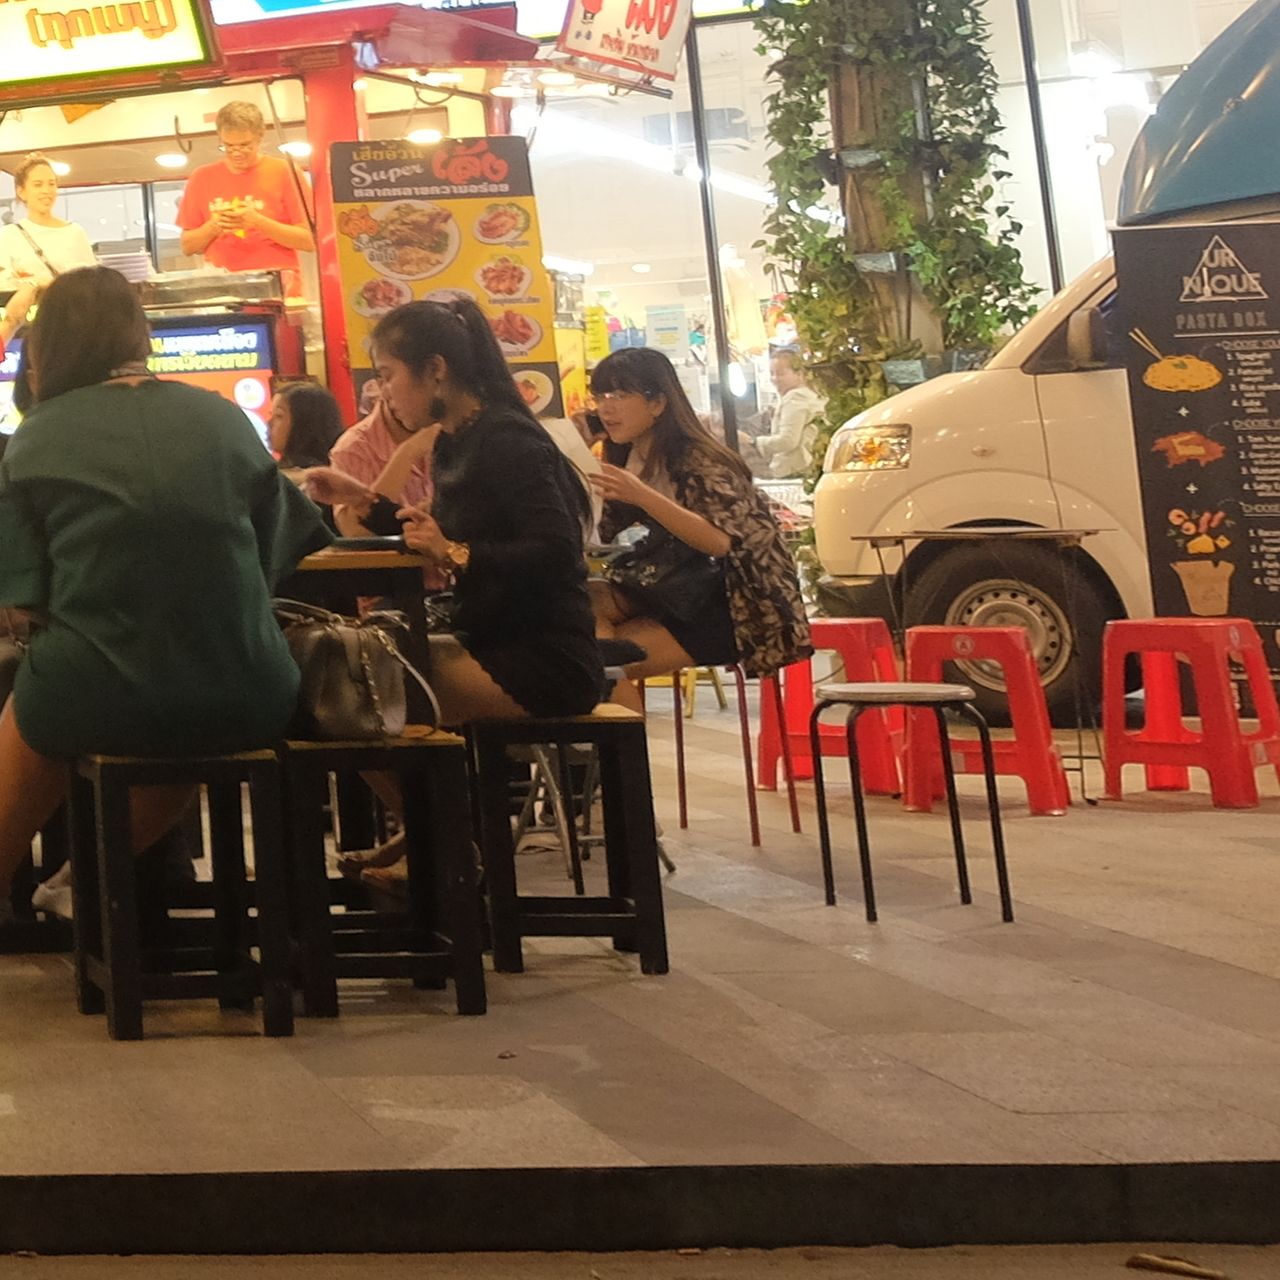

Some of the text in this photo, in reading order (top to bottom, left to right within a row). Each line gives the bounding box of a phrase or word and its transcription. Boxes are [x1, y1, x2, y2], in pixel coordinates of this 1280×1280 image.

[350, 162, 424, 187] Super
[1202, 248, 1236, 269] UR
[1176, 311, 1268, 330] PASTA BOX
